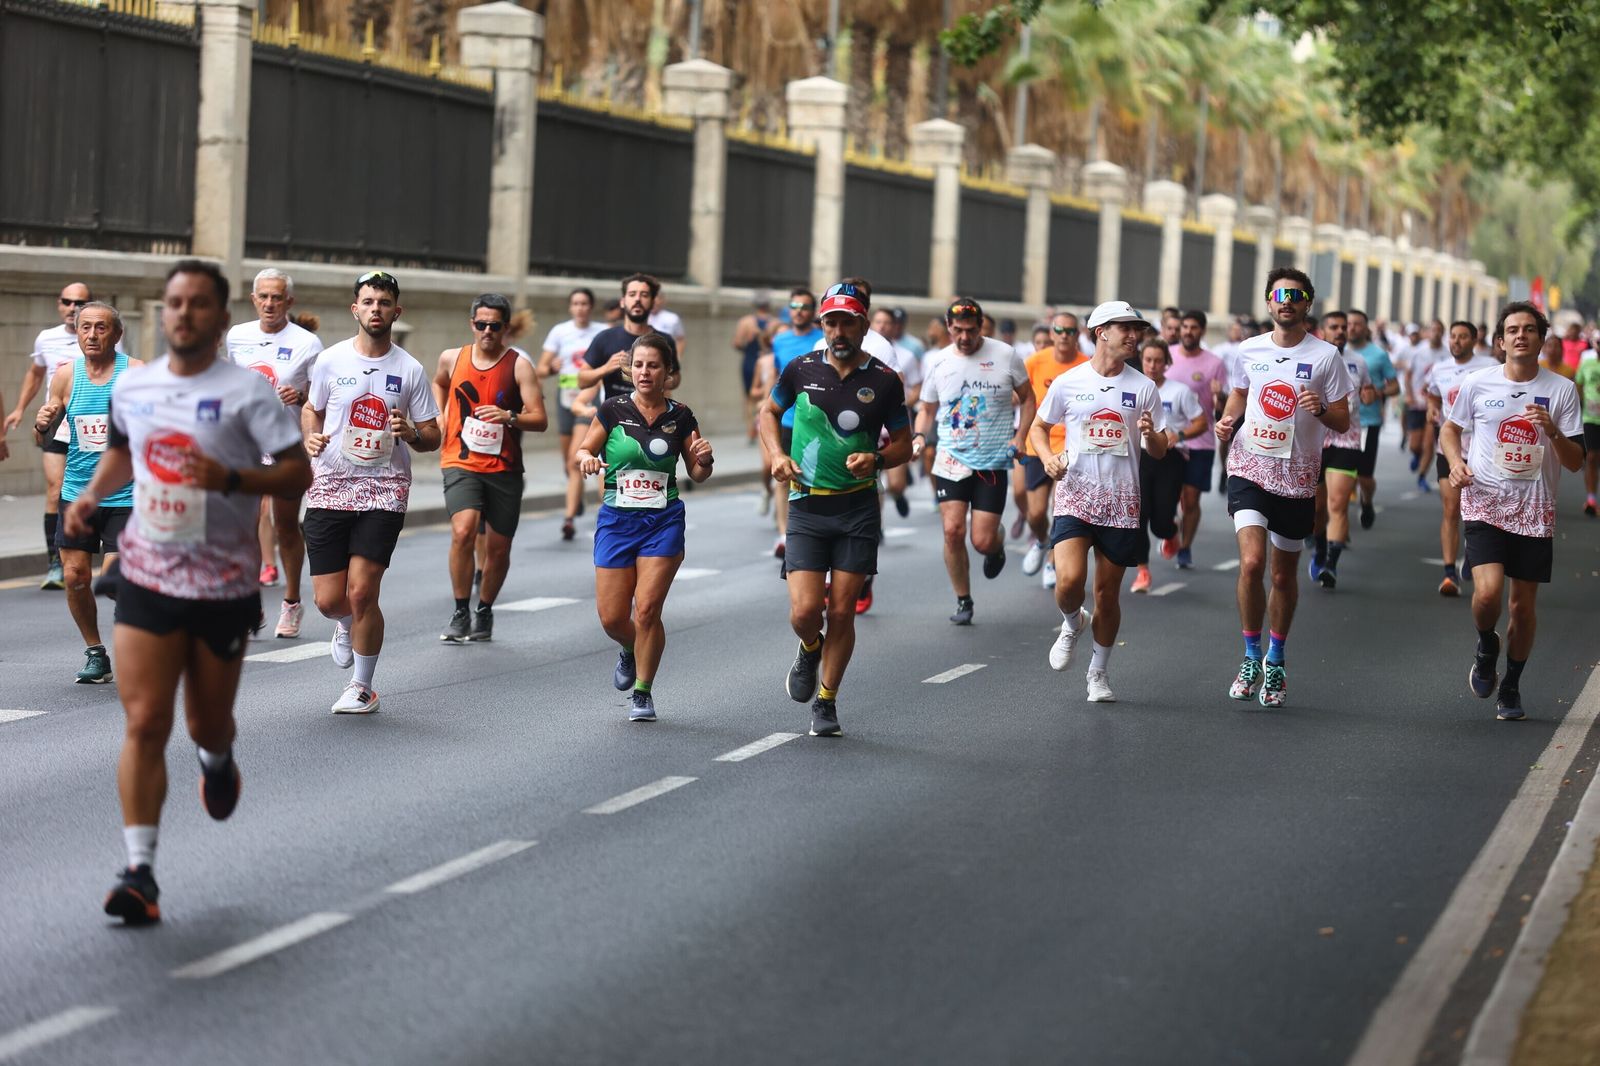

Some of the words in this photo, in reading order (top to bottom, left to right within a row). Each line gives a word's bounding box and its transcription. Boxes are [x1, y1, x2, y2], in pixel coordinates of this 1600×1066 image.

[1266, 388, 1294, 406] PONLE
[1263, 396, 1291, 412] FRENO
[356, 403, 385, 420] PONLE
[353, 411, 382, 428] FRENO
[82, 424, 107, 435] 117
[469, 427, 498, 439] 1024
[1089, 427, 1122, 438] 1166
[1253, 427, 1286, 441] 1280
[1504, 424, 1534, 439] PONLE
[353, 437, 381, 450] 211
[1504, 452, 1532, 463] 534
[625, 479, 660, 490] 1036
